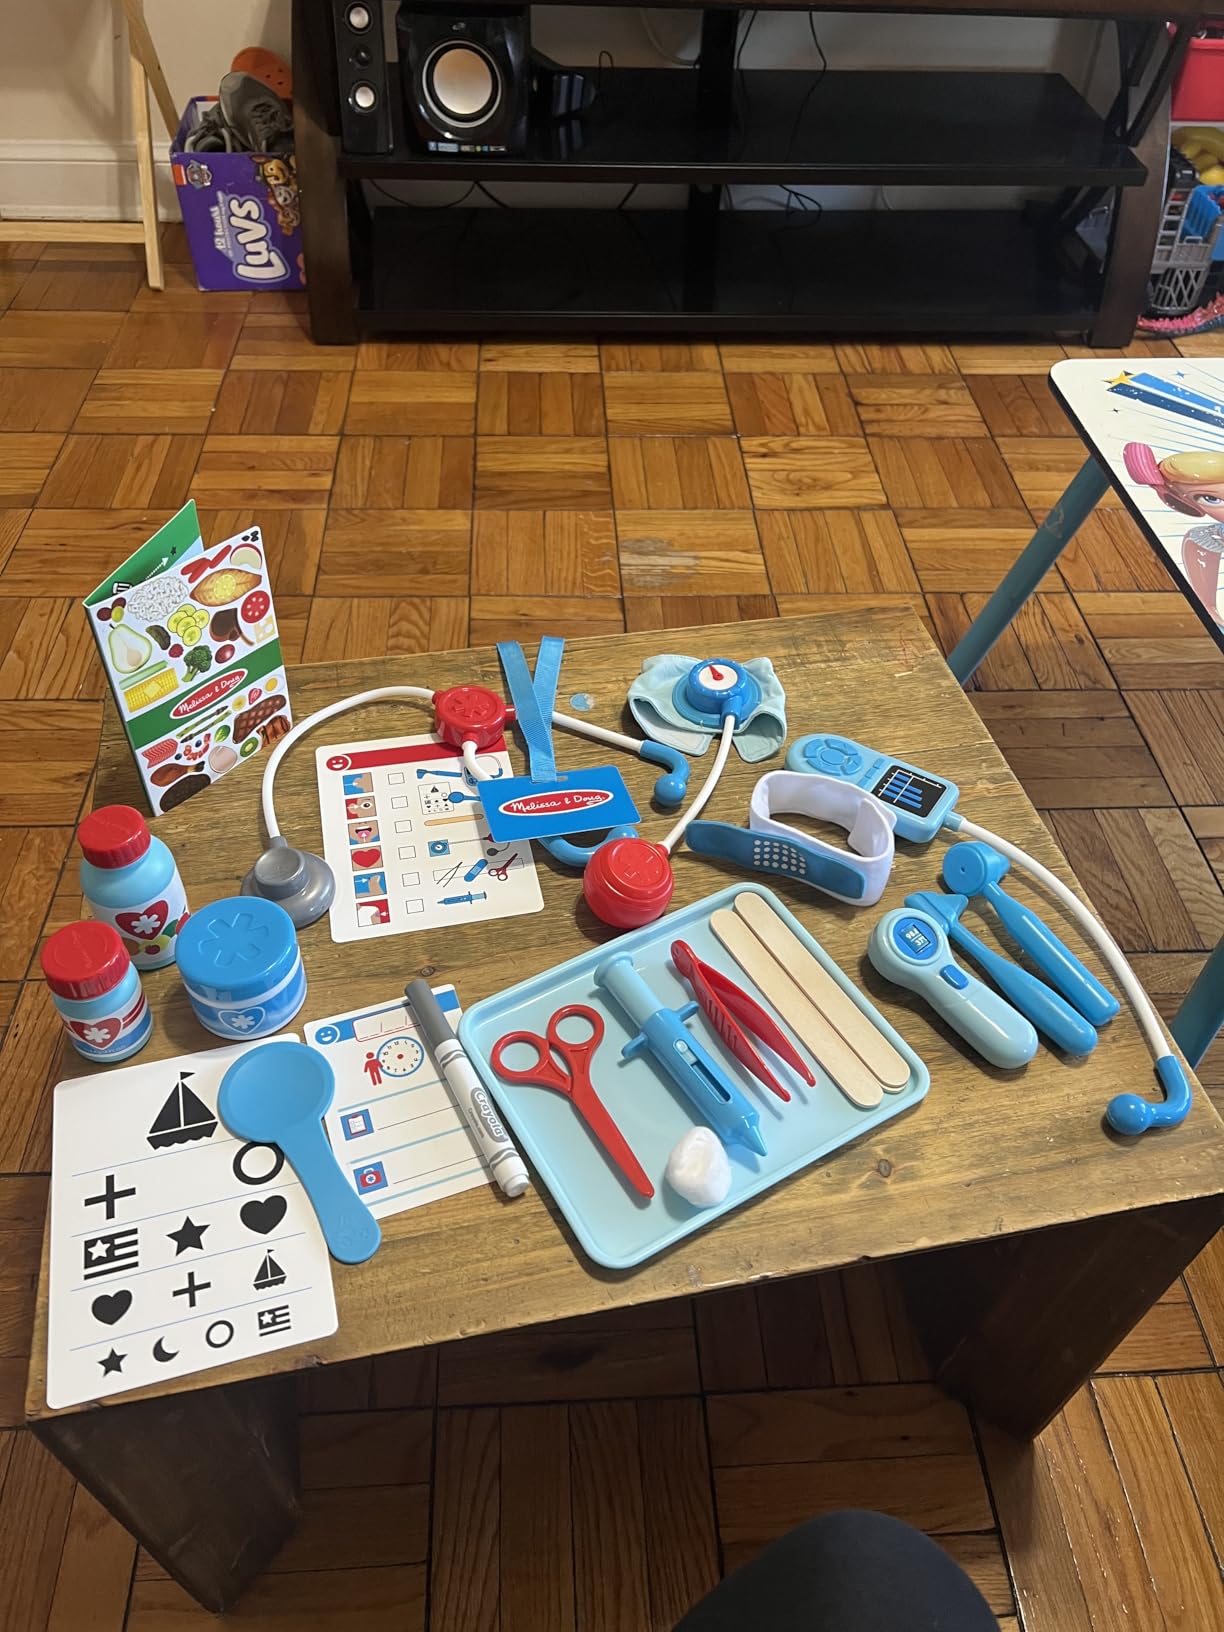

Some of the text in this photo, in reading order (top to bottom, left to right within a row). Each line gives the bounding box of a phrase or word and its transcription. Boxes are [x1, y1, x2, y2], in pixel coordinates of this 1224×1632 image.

[178, 691, 214, 714] Melissa
[220, 675, 240, 688] Doug
[510, 801, 562, 812] Melissa
[573, 795, 602, 806] Doug
[475, 1091, 504, 1137] Crayola
